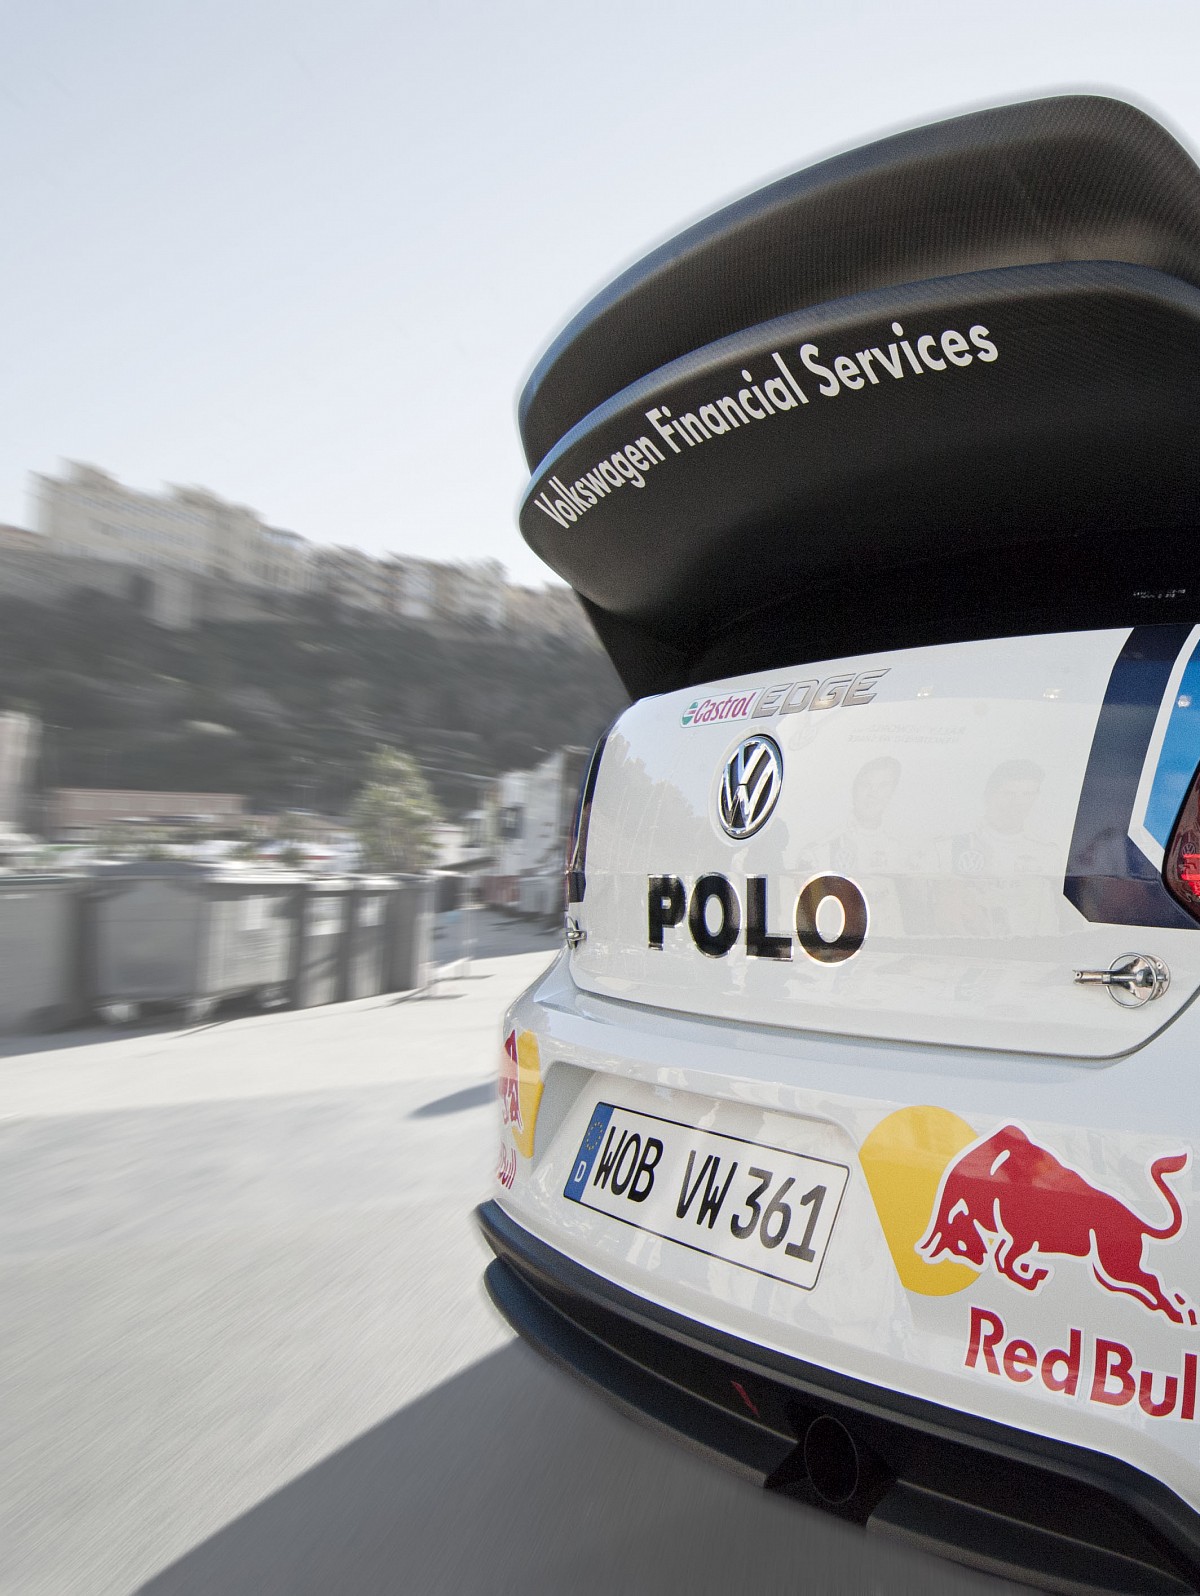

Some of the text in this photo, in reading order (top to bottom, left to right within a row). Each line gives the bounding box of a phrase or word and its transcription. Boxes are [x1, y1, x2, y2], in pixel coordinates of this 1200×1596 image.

[534, 322, 999, 529] Volkswagen Financial Services
[693, 667, 892, 725] Castrol EDGE
[647, 870, 871, 968] POLO
[573, 1125, 828, 1263] D WOB VW 361
[964, 1306, 1082, 1396] Red
